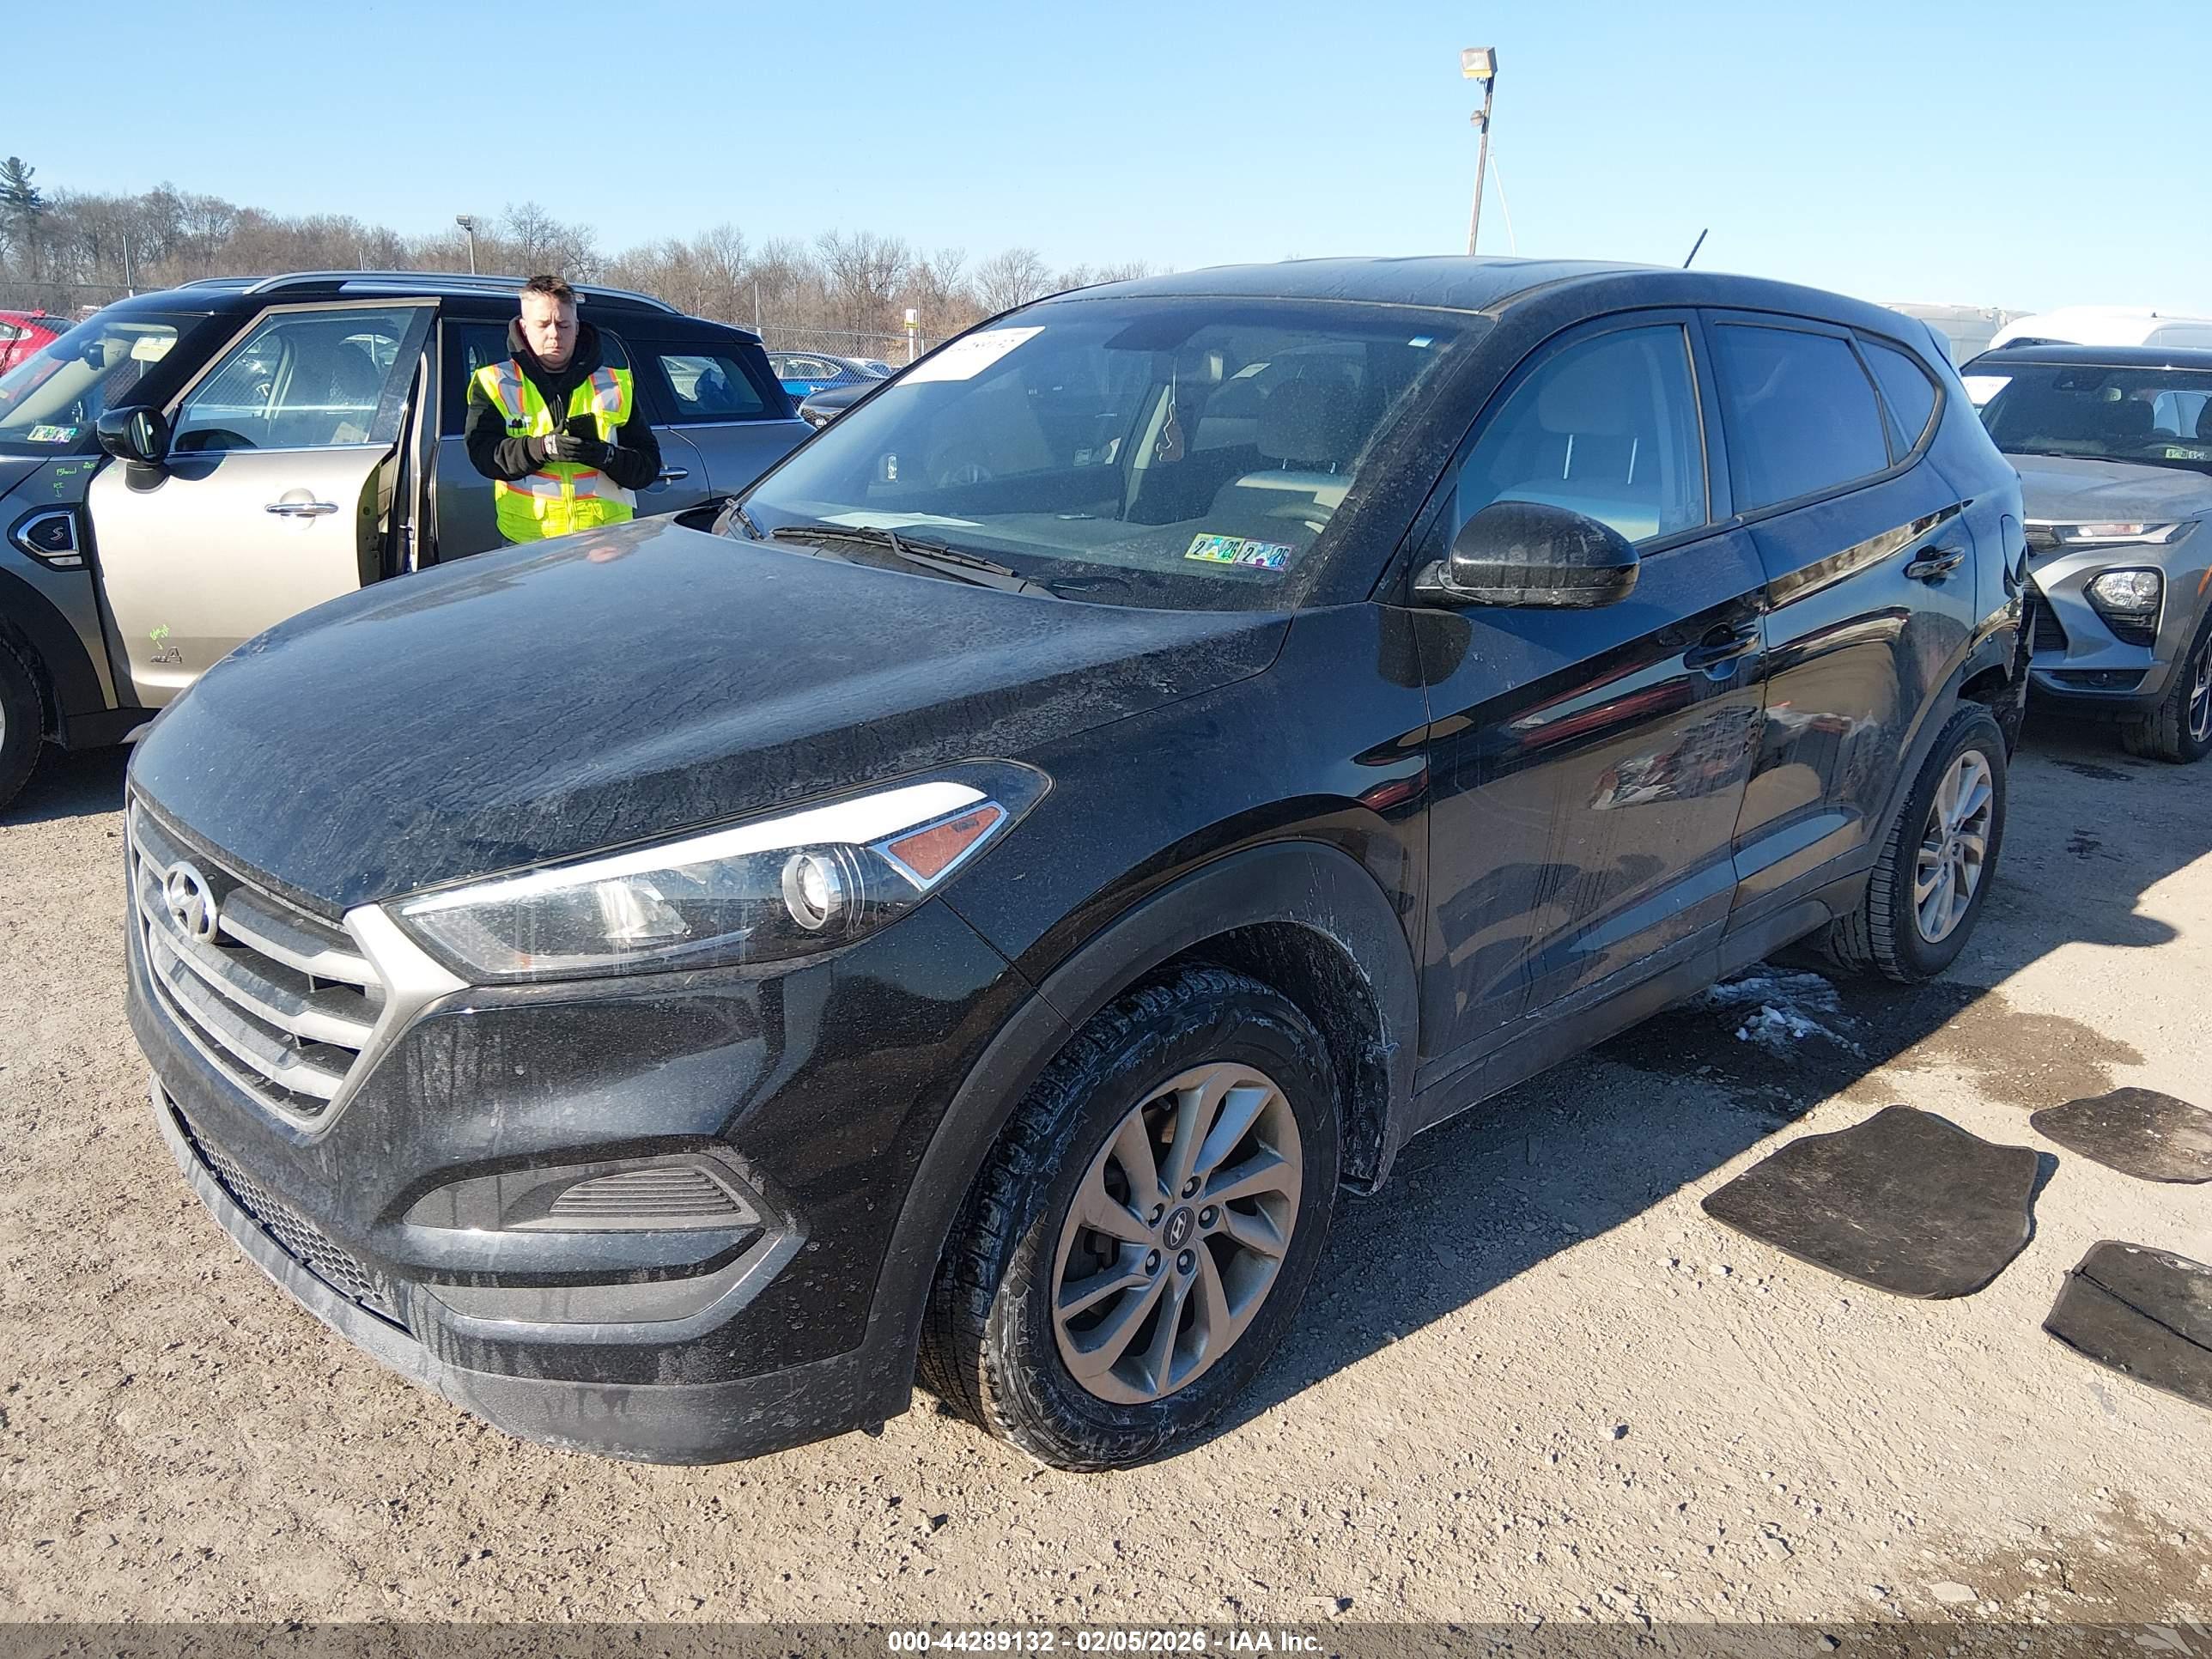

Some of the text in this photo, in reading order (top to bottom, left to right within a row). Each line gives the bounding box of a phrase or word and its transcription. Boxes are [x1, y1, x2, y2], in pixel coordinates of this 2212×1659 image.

[50, 526, 64, 541] S
[1193, 540, 1241, 559] 2 26
[1242, 547, 1290, 566] 2 26
